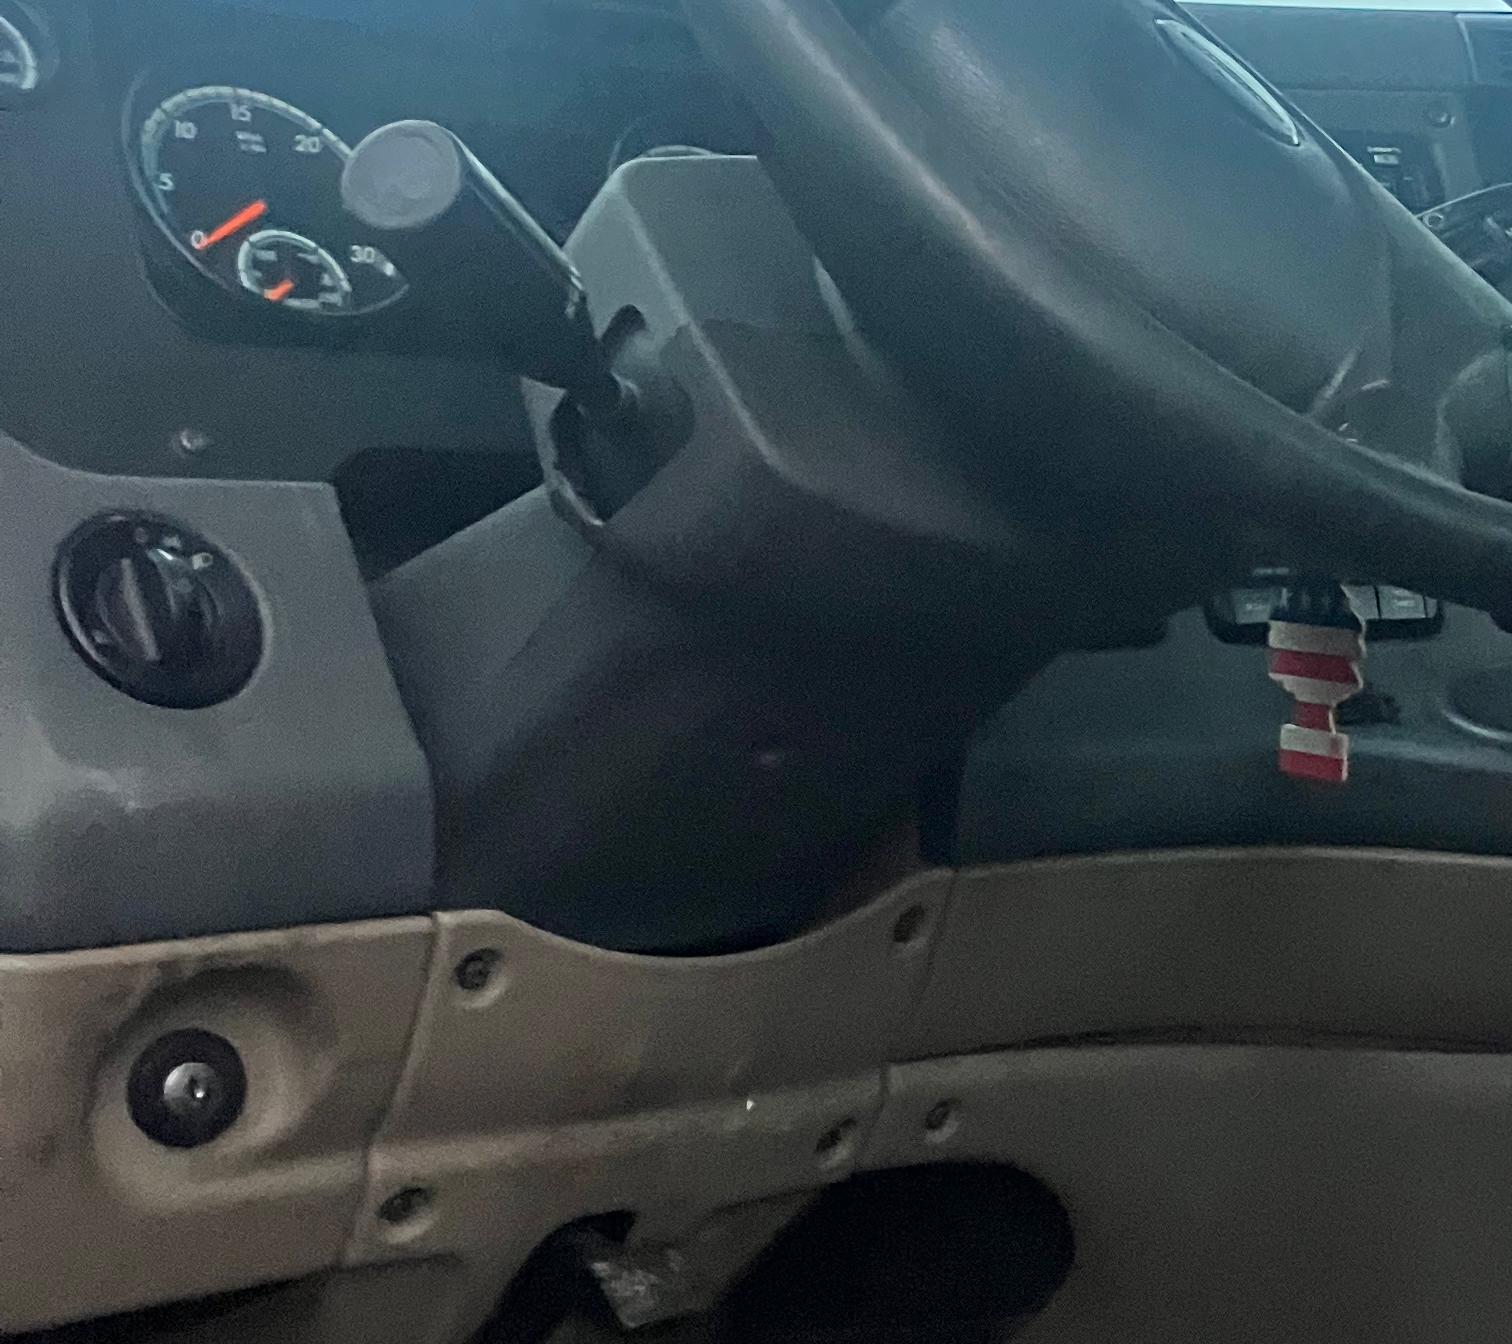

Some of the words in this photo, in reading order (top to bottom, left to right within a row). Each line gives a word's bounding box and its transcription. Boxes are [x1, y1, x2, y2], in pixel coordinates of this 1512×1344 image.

[231, 105, 252, 122] 15
[174, 120, 198, 139] 10
[295, 134, 323, 153] 20
[157, 172, 176, 191] 5
[190, 229, 207, 250] 0
[350, 244, 376, 264] 30
